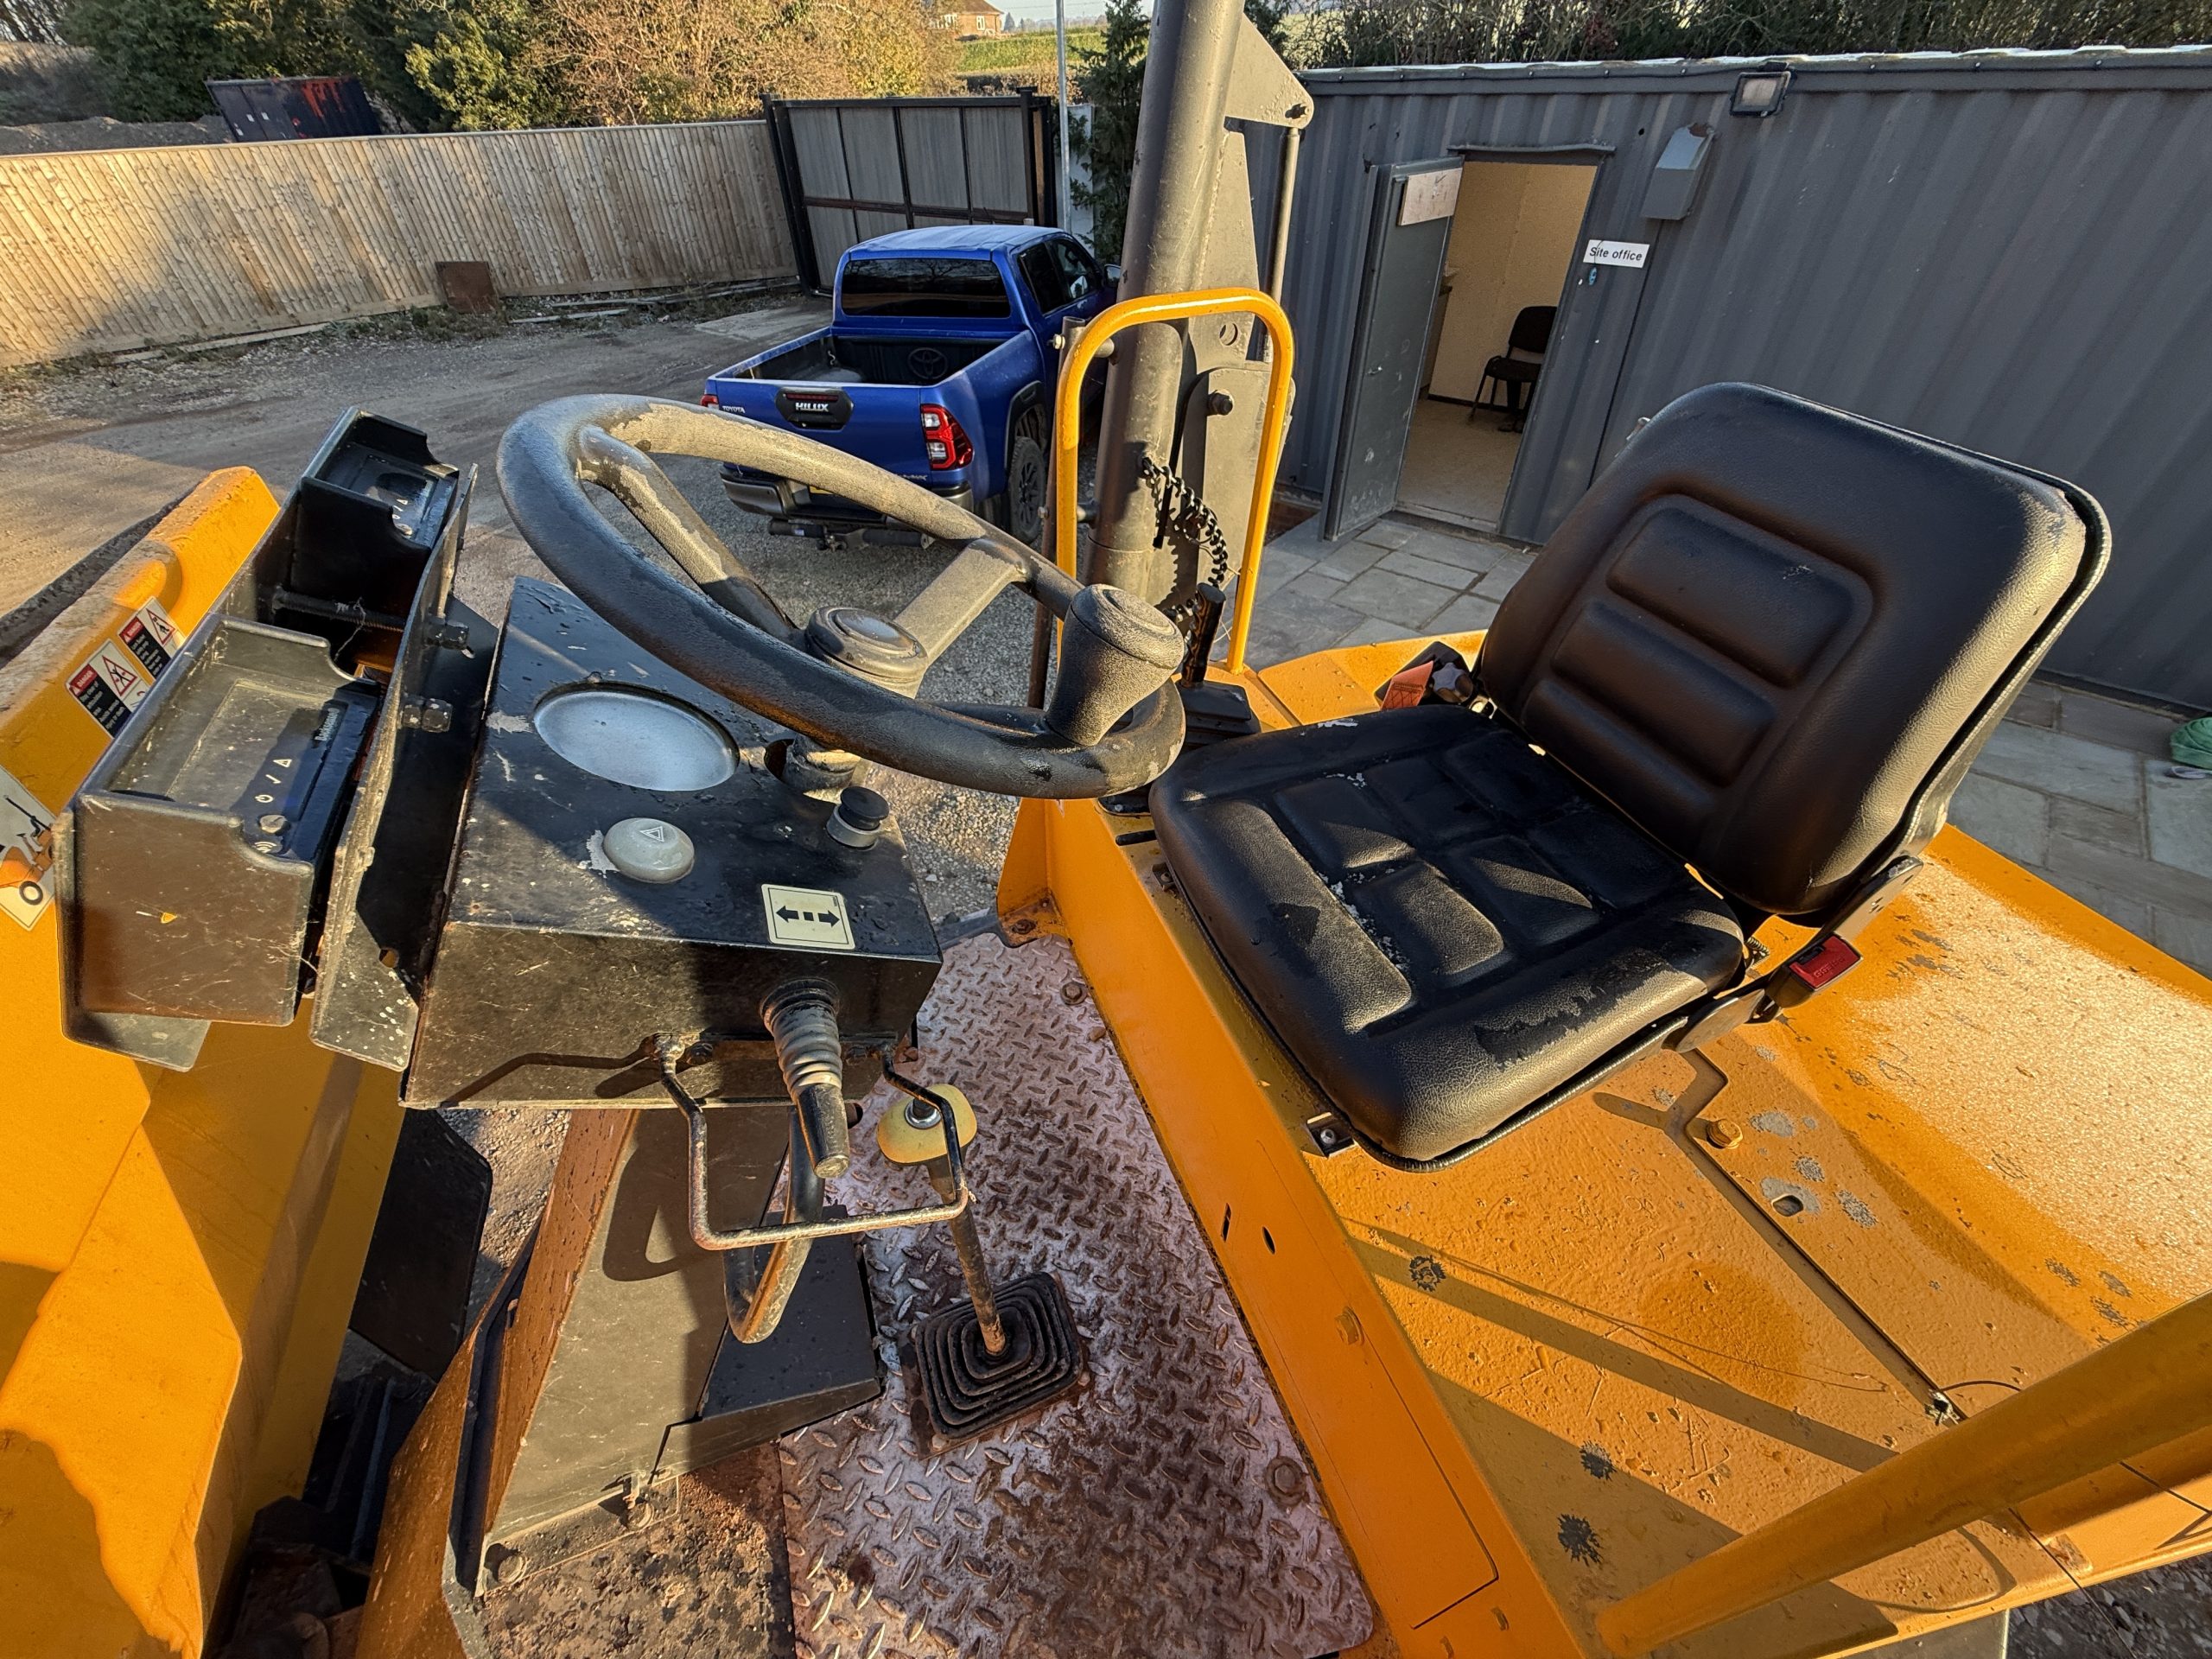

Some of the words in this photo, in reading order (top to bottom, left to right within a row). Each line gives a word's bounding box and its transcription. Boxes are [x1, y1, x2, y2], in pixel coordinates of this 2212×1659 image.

[1589, 246, 1609, 257] Site
[1611, 249, 1643, 261] office
[722, 405, 746, 414] TOYOTA
[795, 402, 830, 412] HILUX
[77, 670, 93, 688] DANGER
[1813, 957, 1846, 978] PRESS
